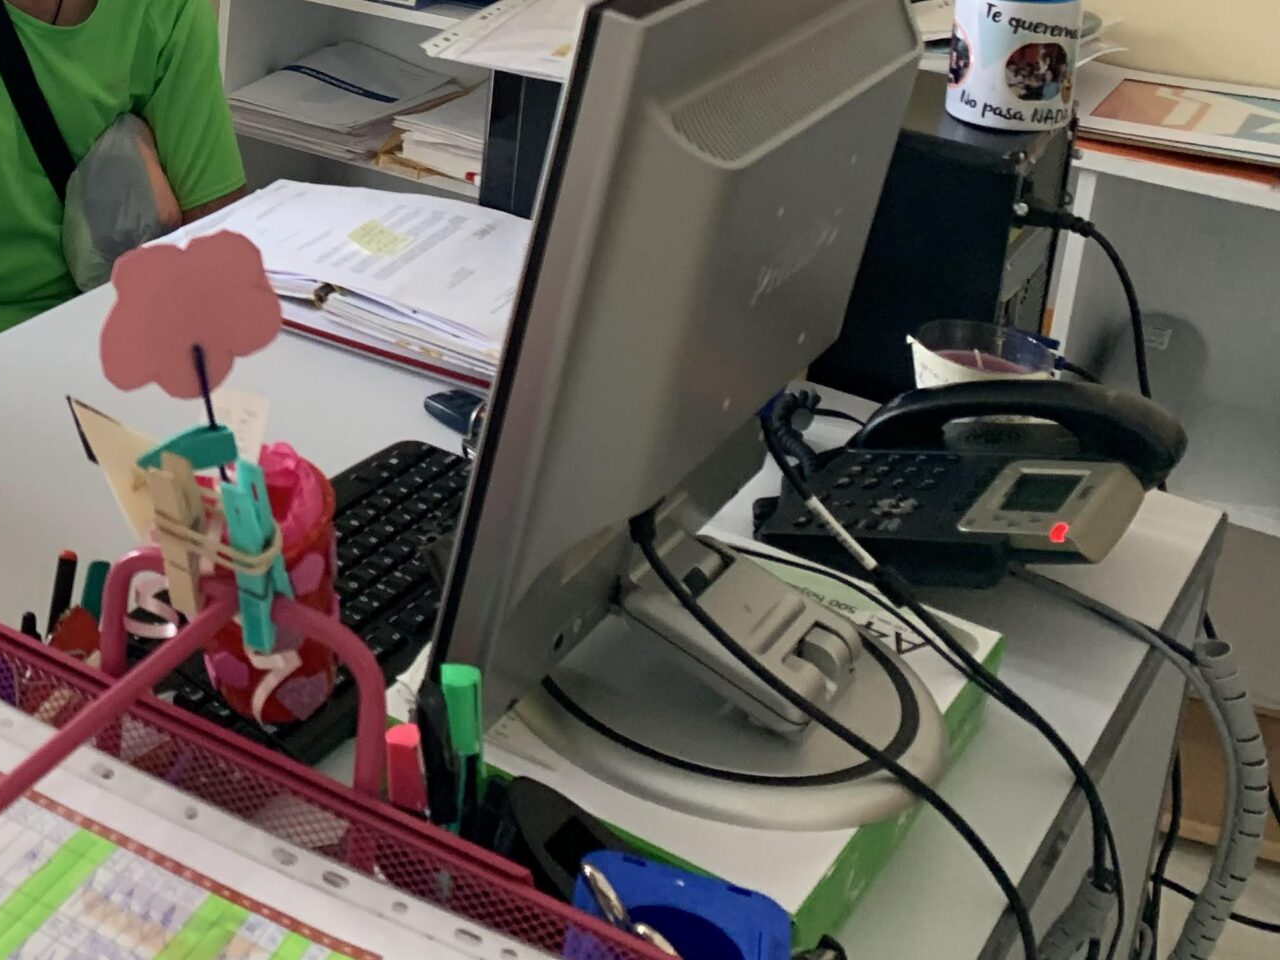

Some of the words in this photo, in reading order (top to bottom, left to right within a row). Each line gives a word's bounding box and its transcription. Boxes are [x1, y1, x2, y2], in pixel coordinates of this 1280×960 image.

[986, 2, 1002, 23] Te
[960, 89, 977, 108] No
[981, 102, 1025, 121] pasa
[829, 598, 858, 615] 500
